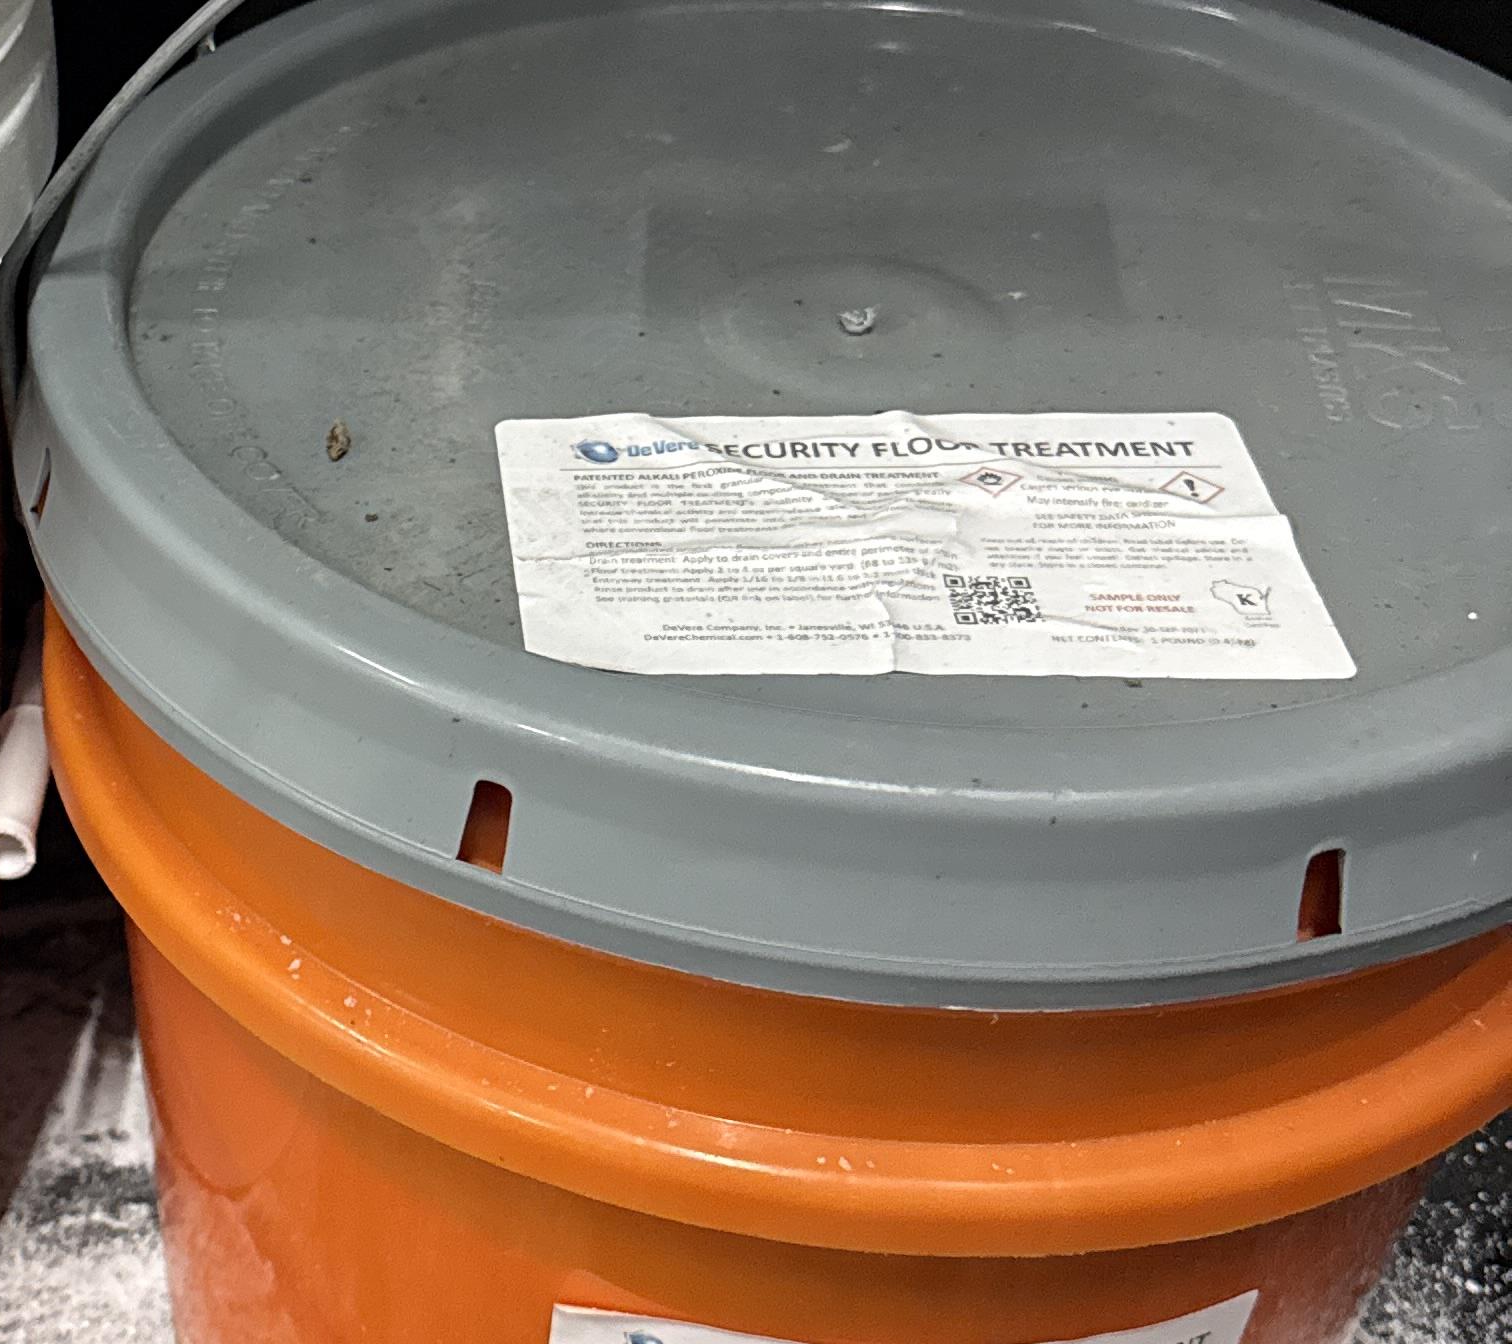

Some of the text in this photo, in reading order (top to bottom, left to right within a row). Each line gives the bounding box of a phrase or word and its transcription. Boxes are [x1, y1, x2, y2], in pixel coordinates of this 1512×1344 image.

[627, 439, 700, 457] DeVere
[705, 441, 866, 459] SECURITY
[988, 441, 1195, 457] TREATMENT
[573, 473, 635, 481] PATENTED
[638, 473, 680, 481] ALKALI
[865, 472, 939, 480] TREATMENT
[585, 541, 662, 549] DIRECTIONS
[1089, 593, 1181, 602] SAMPLE ONLY
[1235, 593, 1258, 606] K
[1146, 605, 1195, 613] RESALE
